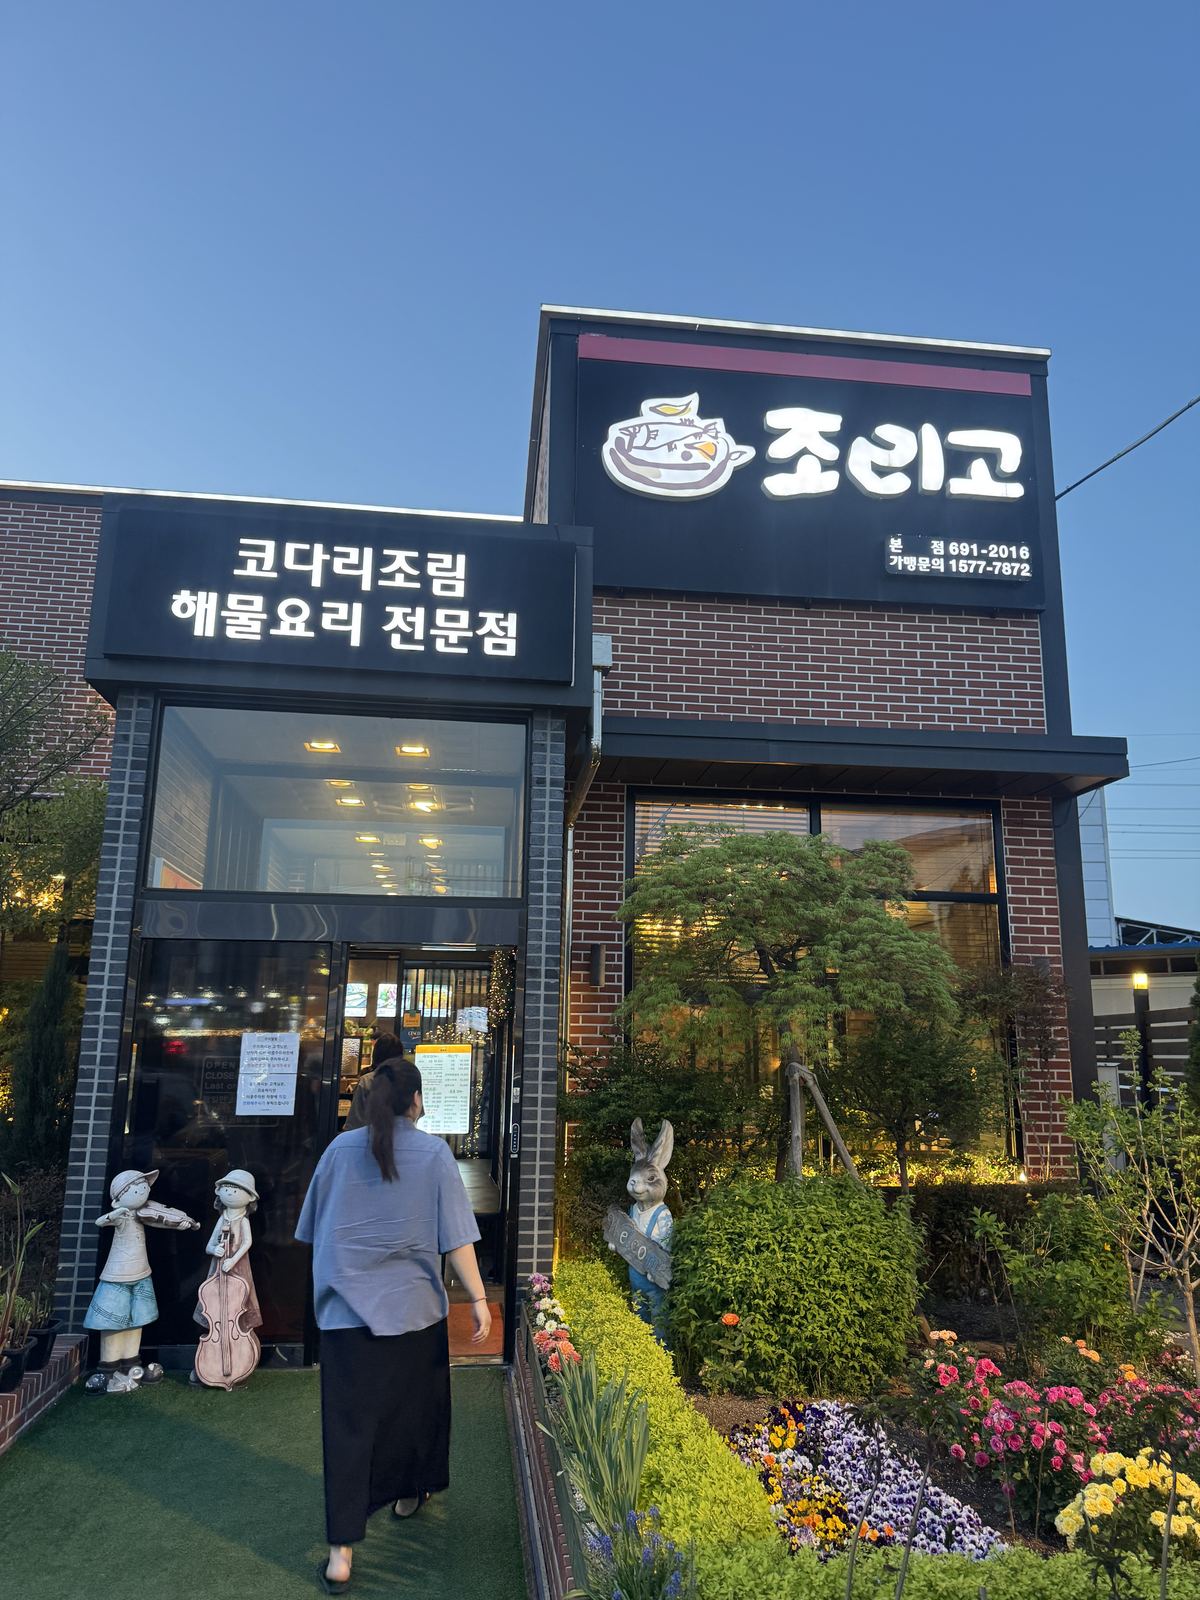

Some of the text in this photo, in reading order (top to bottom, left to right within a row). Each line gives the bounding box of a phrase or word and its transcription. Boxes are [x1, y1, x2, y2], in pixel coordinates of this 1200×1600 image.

[762, 407, 1025, 499] 조리고
[889, 536, 1030, 560] 본 점 691-2016
[232, 537, 467, 598] 코다리조림
[889, 555, 1033, 578] 가맹문의 1577-7872
[171, 589, 519, 658] 해물요리 전문점
[205, 1061, 236, 1069] OPEN
[205, 1071, 235, 1080] CLOSE
